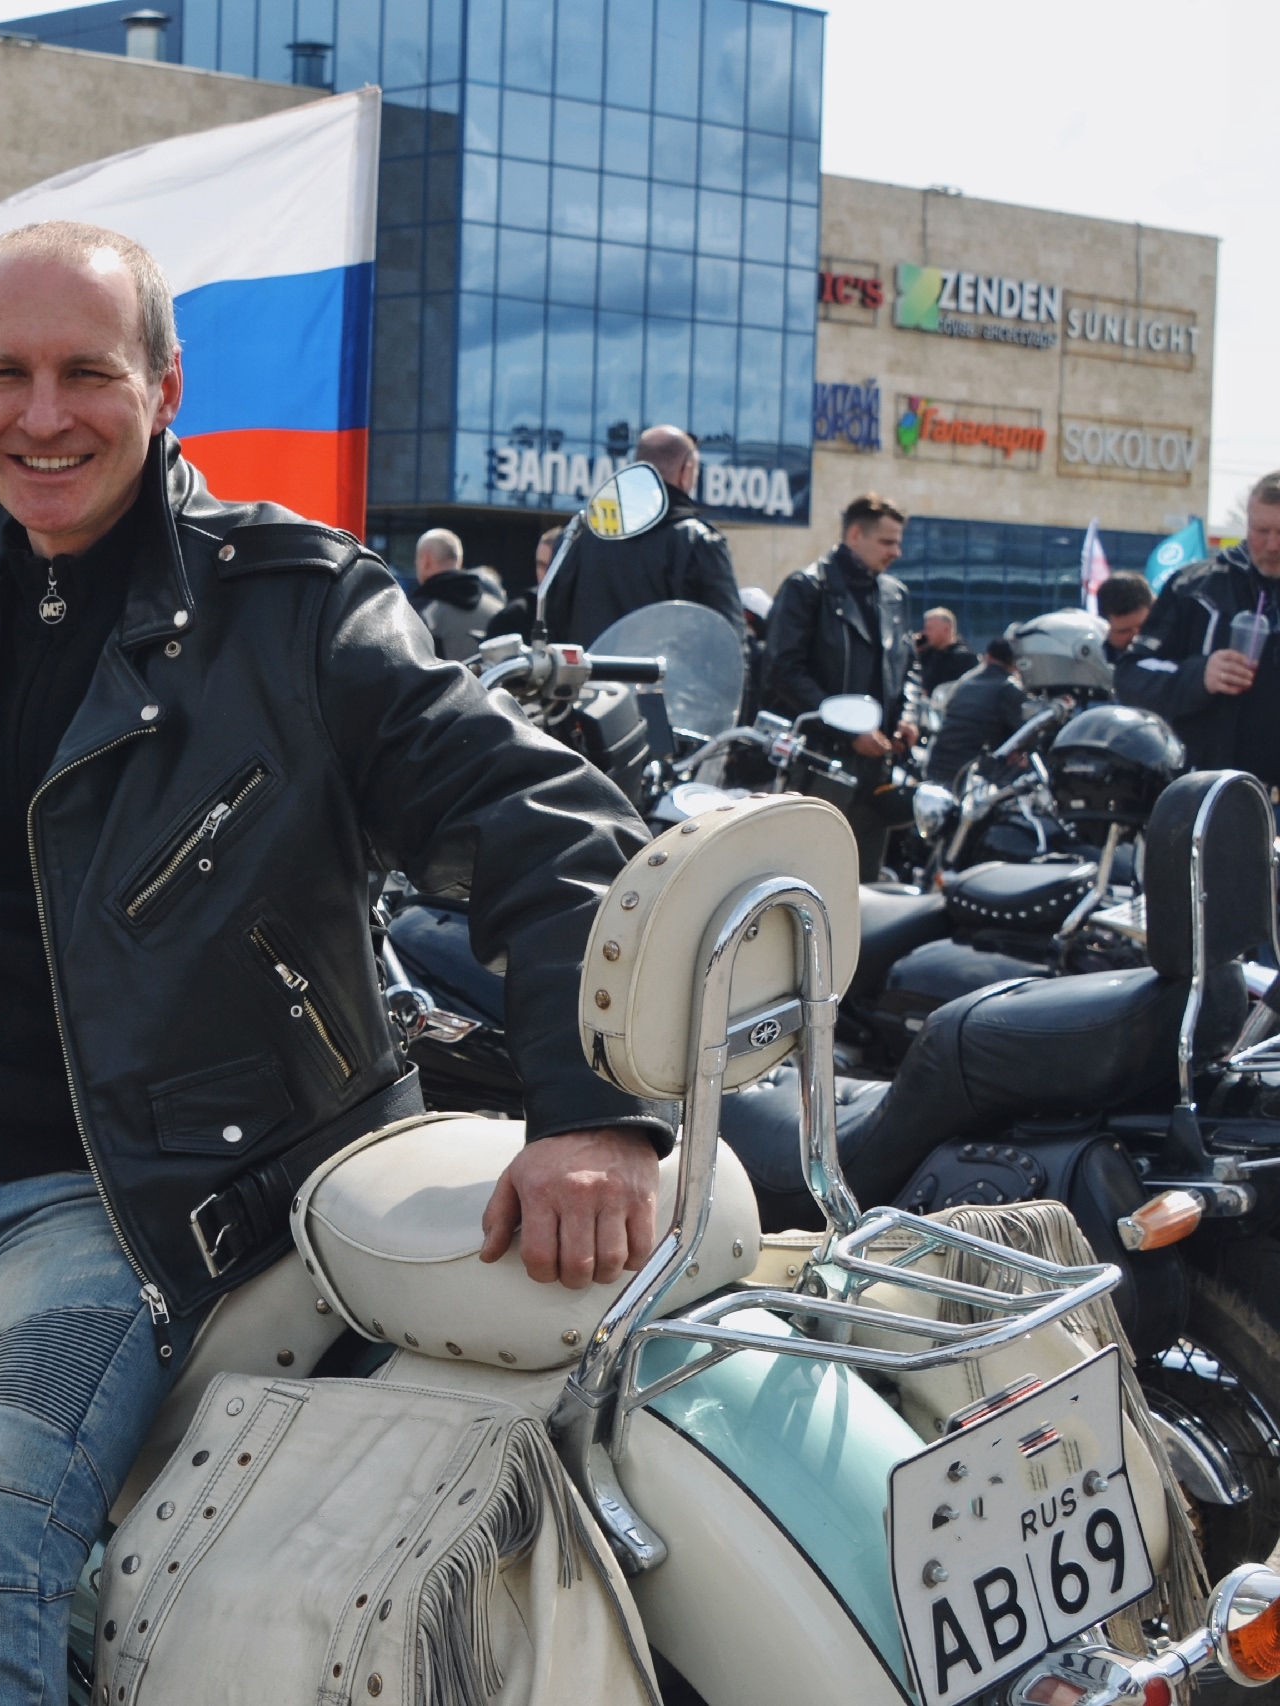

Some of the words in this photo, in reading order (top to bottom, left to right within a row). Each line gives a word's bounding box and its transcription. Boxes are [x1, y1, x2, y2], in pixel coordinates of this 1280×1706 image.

[936, 270, 1063, 323] ZENDEN
[1067, 307, 1200, 355] SUNLIGHT
[1063, 424, 1200, 473] SOKOLOV
[705, 465, 793, 516] ВХОД
[1021, 1487, 1078, 1541] RUS
[1050, 1508, 1125, 1615] 69
[932, 1566, 1027, 1695] AB
